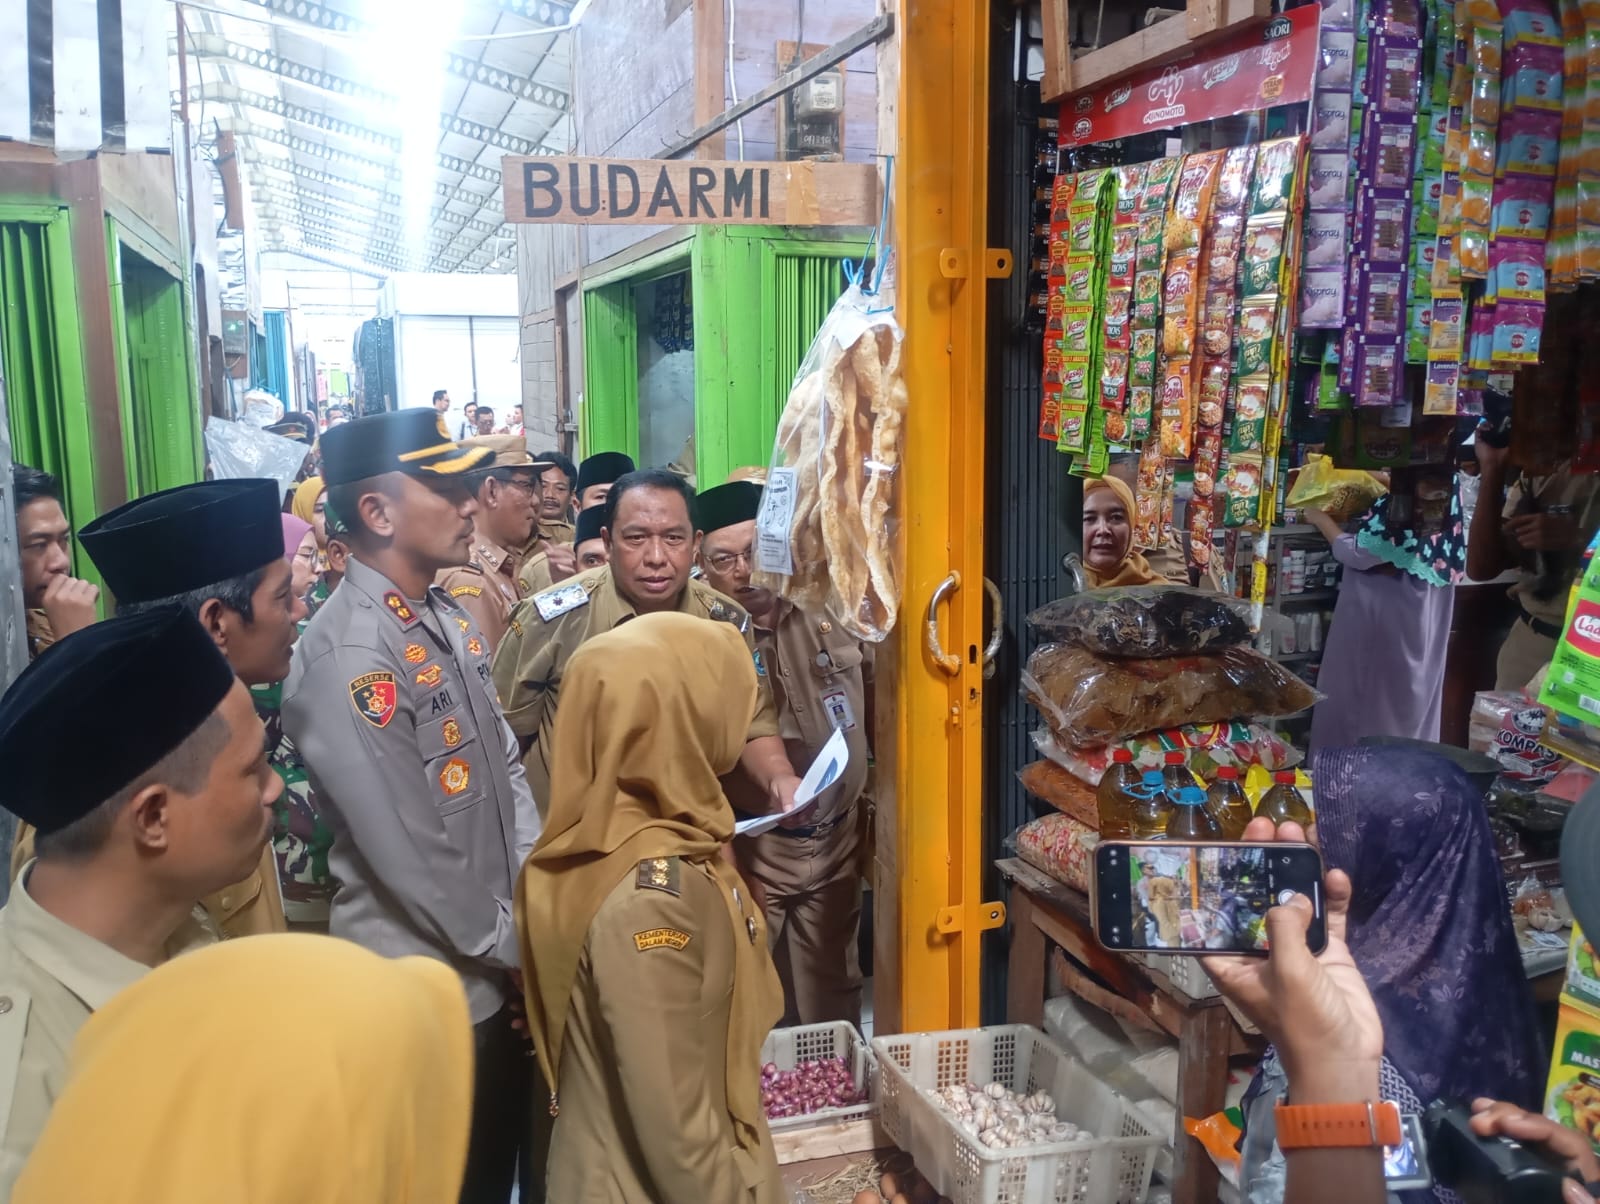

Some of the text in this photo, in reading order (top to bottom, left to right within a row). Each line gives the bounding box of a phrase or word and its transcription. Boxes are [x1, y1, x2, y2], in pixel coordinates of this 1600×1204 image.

[1264, 22, 1290, 40] SAORI
[353, 673, 391, 687] RESERSE
[431, 689, 453, 715] ARI
